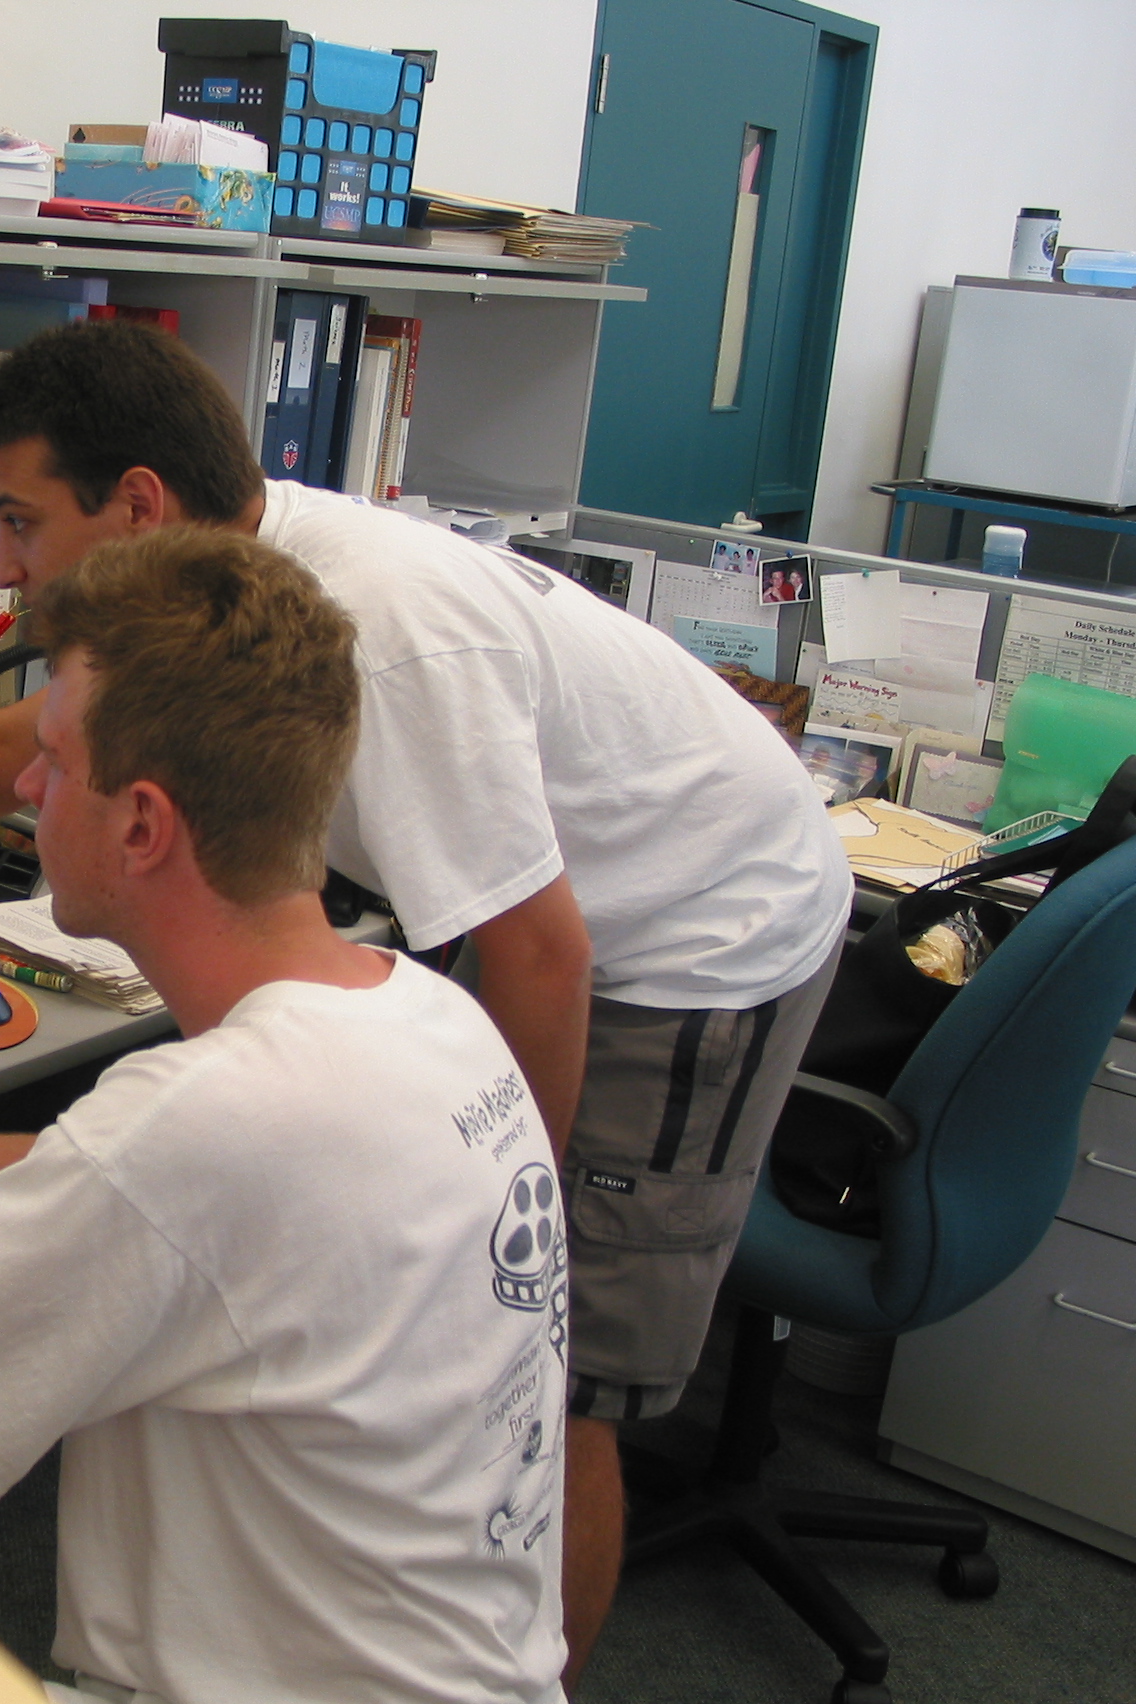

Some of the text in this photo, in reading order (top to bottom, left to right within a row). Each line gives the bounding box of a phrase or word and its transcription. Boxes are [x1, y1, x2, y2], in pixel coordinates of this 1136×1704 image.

[340, 181, 349, 192] It
[329, 191, 361, 204] works!
[324, 205, 361, 222] UCSMP
[1075, 620, 1135, 637] Daily Schedule
[1065, 631, 1096, 644] Monday
[822, 674, 898, 699] Major Warning Sign
[451, 1103, 493, 1149] Movie
[485, 1374, 537, 1430] together
[508, 1403, 535, 1441] first
